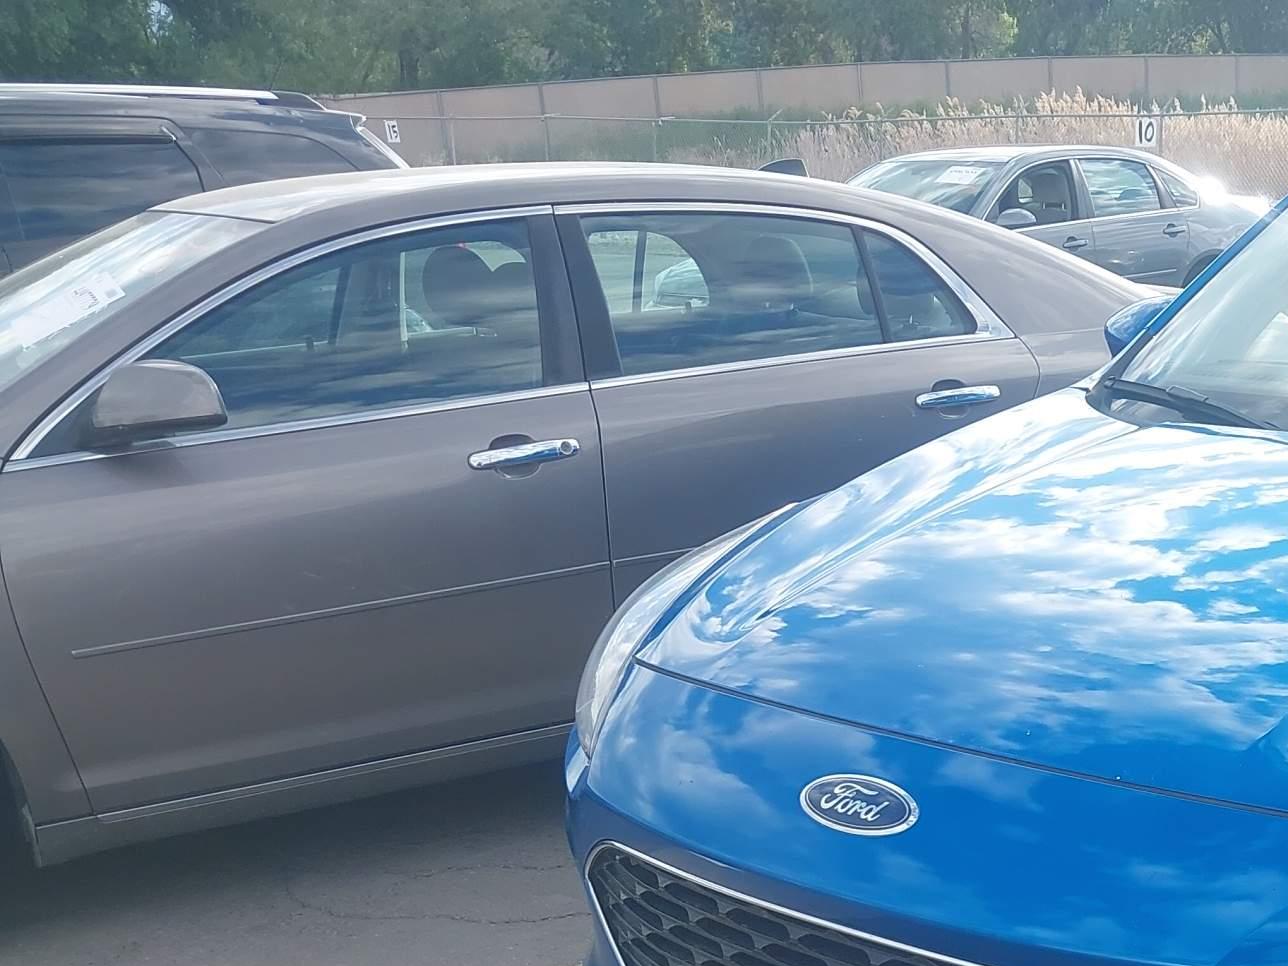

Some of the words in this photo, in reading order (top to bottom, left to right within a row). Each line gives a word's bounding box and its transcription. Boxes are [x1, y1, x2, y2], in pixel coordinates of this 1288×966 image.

[387, 122, 399, 140] 15
[1138, 119, 1155, 145] 10
[820, 782, 890, 821] Ford
